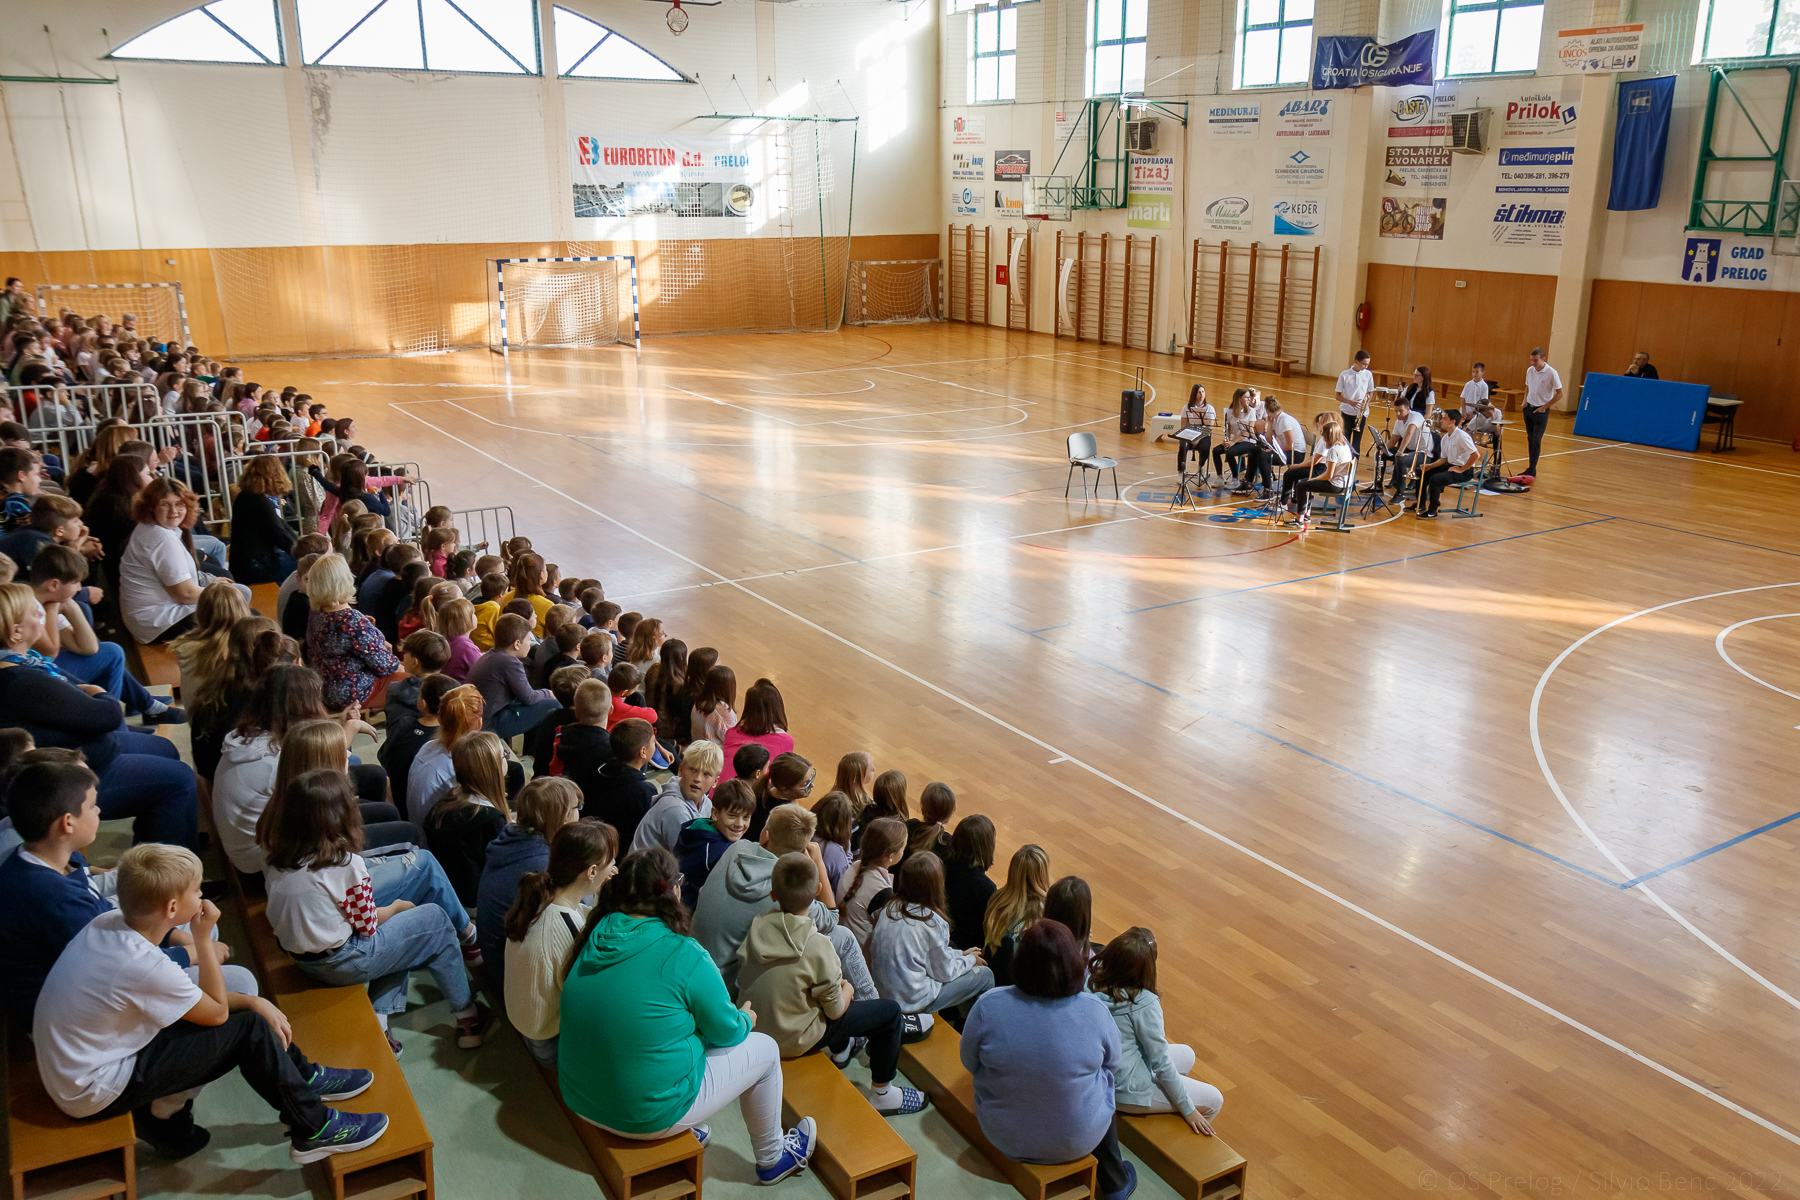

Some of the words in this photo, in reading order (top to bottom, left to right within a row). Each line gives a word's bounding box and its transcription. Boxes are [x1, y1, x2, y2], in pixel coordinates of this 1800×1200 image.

[1559, 48, 1587, 58] LINCOS
[1322, 67, 1358, 77] CROATIA
[1361, 63, 1423, 78] OSIGURANJE
[1519, 94, 1551, 102] Autoškola
[1279, 99, 1332, 116] ABART
[1506, 101, 1561, 121] Prilok
[604, 147, 675, 166] EUROBETON
[1388, 148, 1450, 156] STOLARIJA
[1388, 157, 1449, 165] ZVONAREK
[1134, 165, 1169, 181] Tizaj
[1129, 202, 1170, 221] marti
[1292, 204, 1317, 214] KEDER
[1731, 247, 1764, 260] GRAD
[1721, 267, 1767, 281] PRELOG
